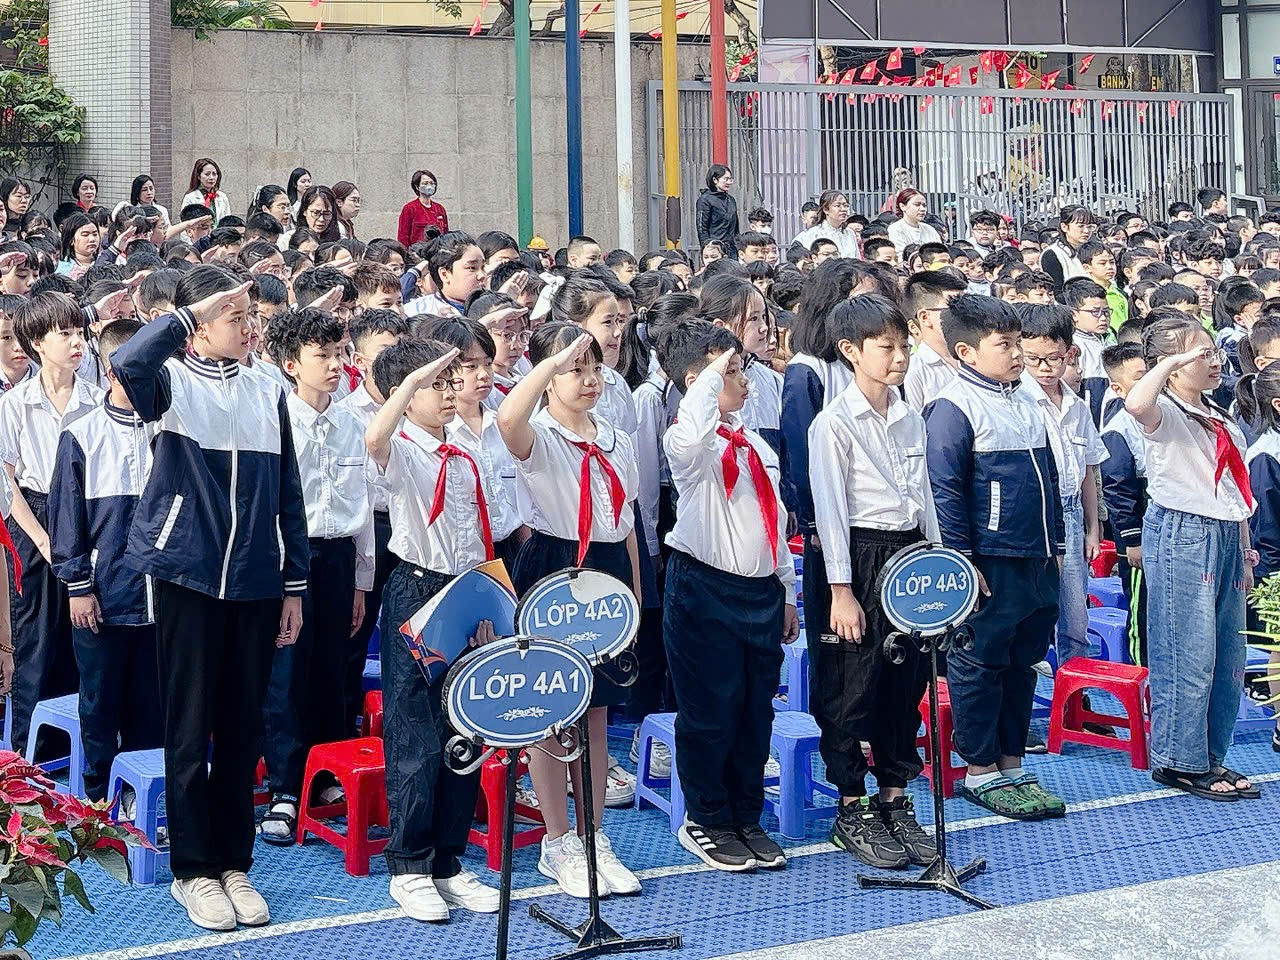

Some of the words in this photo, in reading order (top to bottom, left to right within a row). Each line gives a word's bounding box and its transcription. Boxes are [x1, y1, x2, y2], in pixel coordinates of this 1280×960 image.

[895, 571, 932, 597] LỚP
[936, 571, 967, 592] 4A3
[534, 599, 578, 628] LỚP
[584, 597, 624, 621] 4A2
[469, 668, 526, 700] LỚP
[533, 669, 580, 694] 4A1
